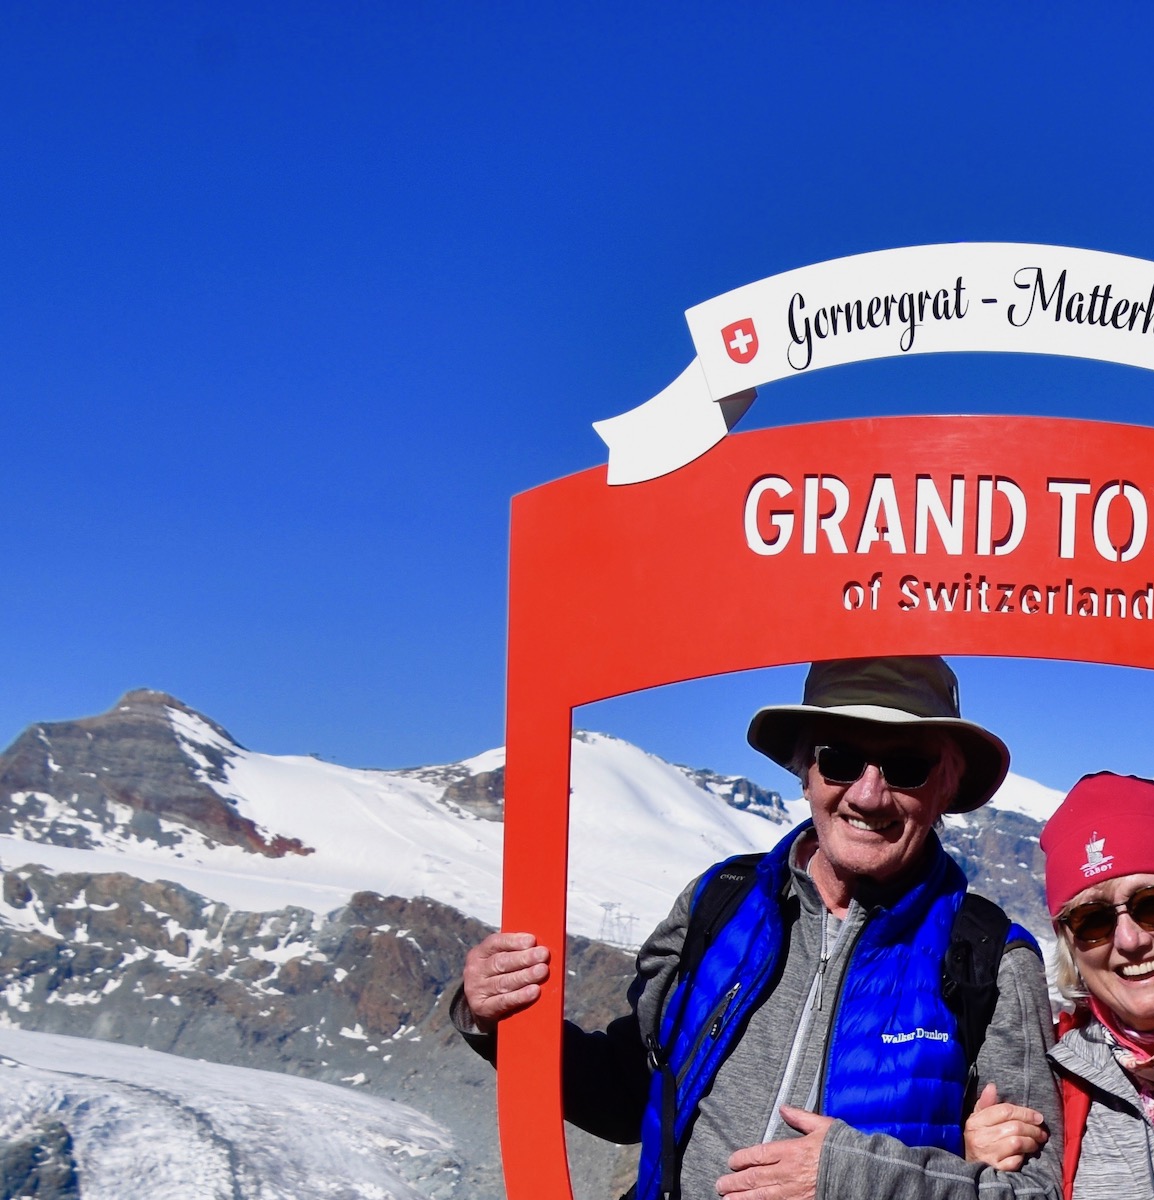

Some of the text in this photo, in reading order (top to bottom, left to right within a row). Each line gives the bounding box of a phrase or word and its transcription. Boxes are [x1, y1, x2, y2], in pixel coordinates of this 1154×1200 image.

[787, 276, 969, 370] Gornergrat
[743, 473, 1028, 556] GRAND
[842, 571, 1154, 620] of Switzerland
[1084, 863, 1113, 878] CABOT
[881, 1028, 949, 1044] Walker Dunlop
